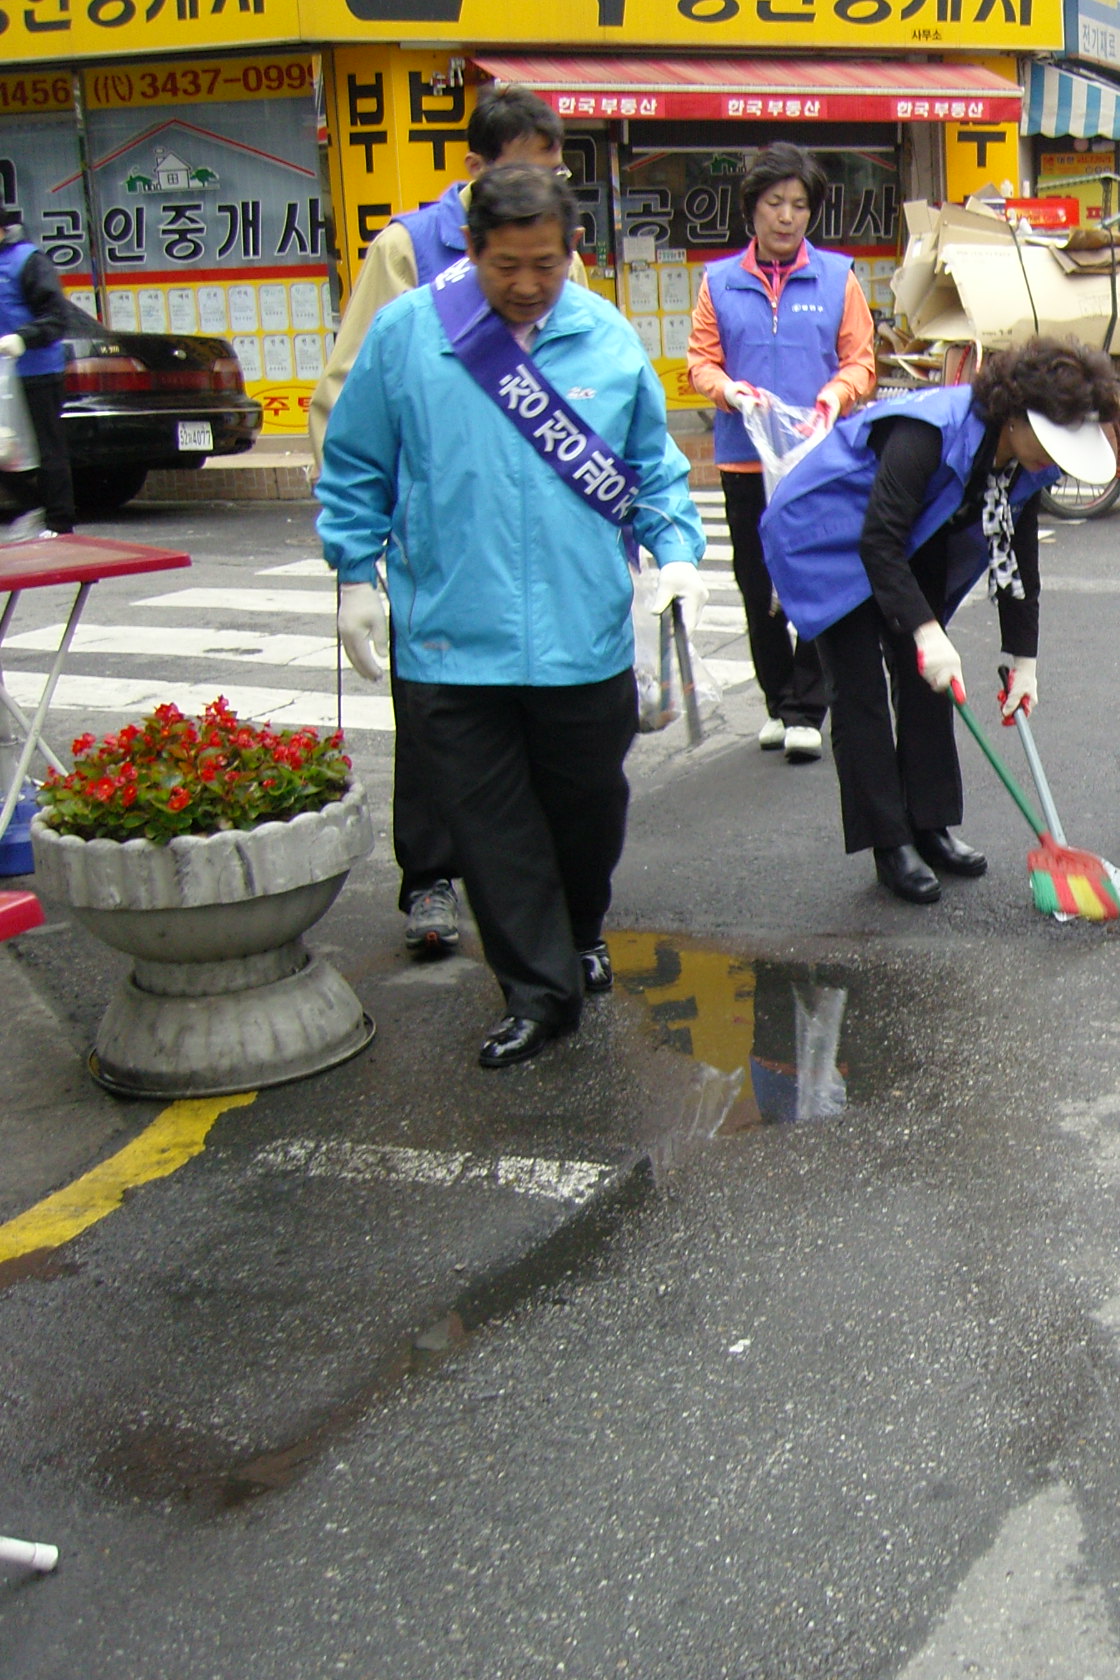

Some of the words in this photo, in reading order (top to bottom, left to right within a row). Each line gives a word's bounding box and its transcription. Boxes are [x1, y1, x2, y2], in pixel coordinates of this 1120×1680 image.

[912, 29, 942, 41] 사무소
[558, 98, 596, 115] 한국
[601, 98, 658, 115] 부동산
[728, 99, 763, 116] 한국
[768, 99, 820, 117] 부동산
[897, 101, 930, 118] 한국
[934, 101, 984, 118] 부동산
[626, 184, 899, 243] 공인개사
[42, 198, 326, 268] 공인중개사
